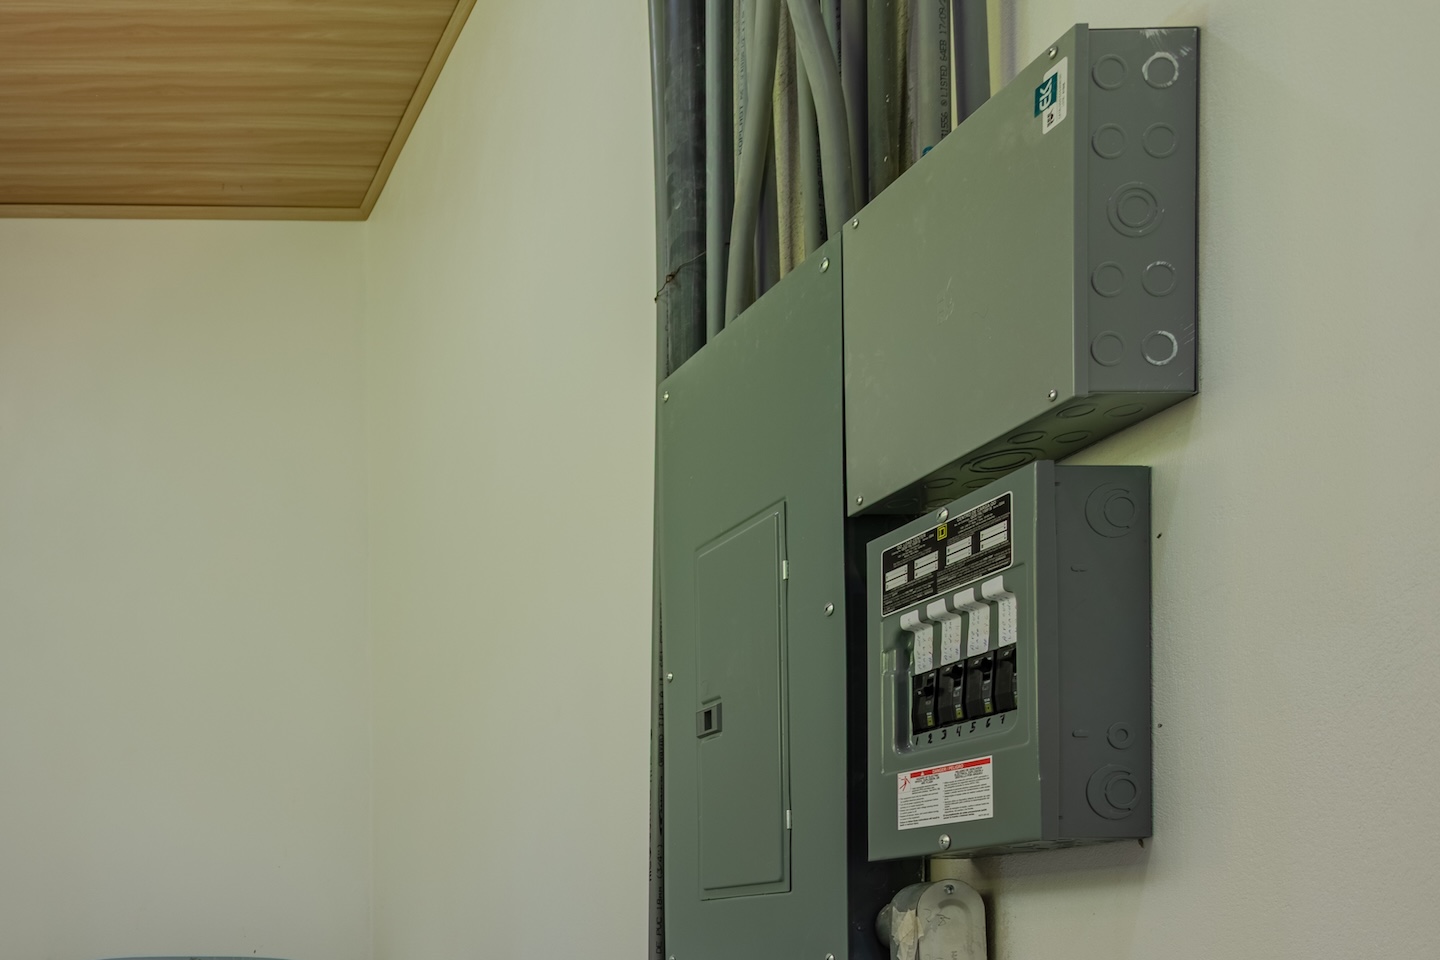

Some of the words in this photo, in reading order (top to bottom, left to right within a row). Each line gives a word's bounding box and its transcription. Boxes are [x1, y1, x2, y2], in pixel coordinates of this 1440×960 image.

[939, 65, 948, 97] LISTED
[927, 733, 933, 744] 2
[941, 729, 947, 740] 3
[956, 726, 962, 737] 4
[969, 722, 977, 733] 5
[985, 718, 991, 728] 6
[1000, 714, 1006, 725] 7
[655, 940, 663, 954] DE
